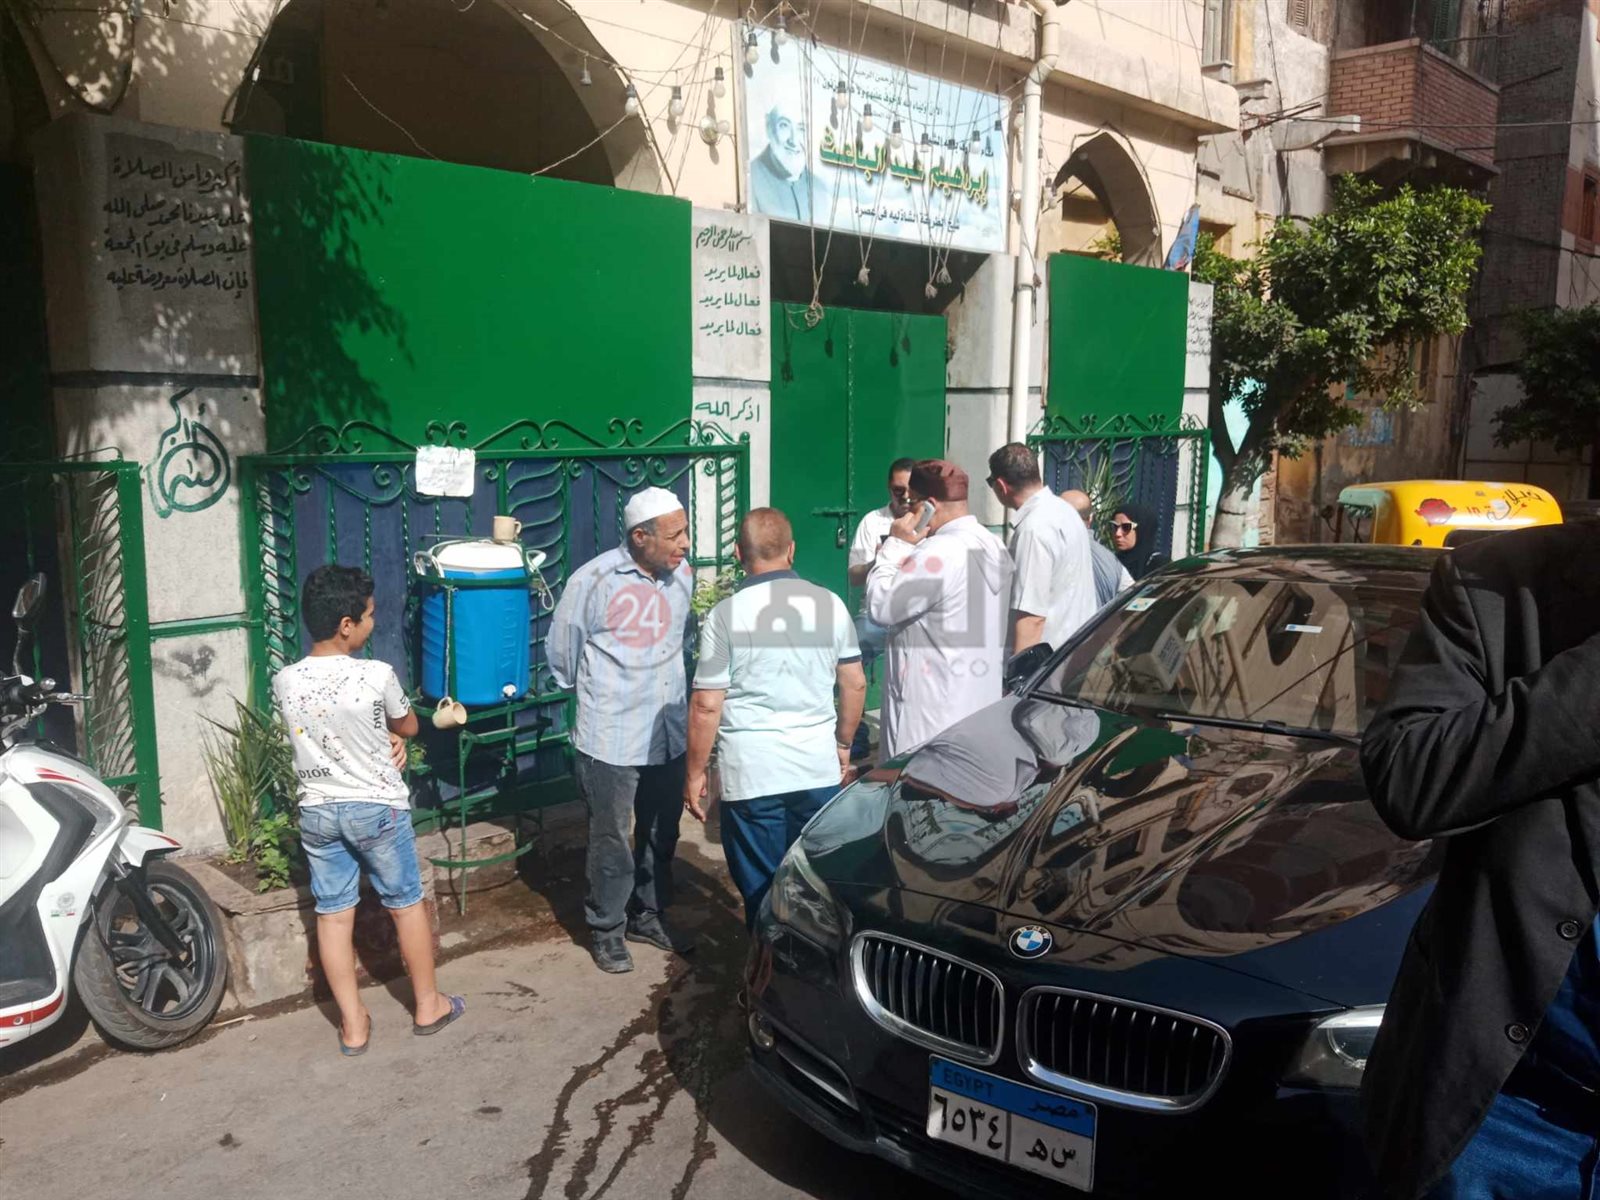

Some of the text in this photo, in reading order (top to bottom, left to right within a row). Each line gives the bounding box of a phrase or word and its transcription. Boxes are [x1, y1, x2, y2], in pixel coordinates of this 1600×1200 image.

[113, 156, 172, 179] الصلاة
[172, 167, 195, 188] من
[103, 198, 131, 218] الله
[182, 234, 214, 263] وسلم
[216, 236, 247, 261] عليه
[703, 264, 761, 283] فعال لما يريد
[699, 292, 761, 309] فعال لما يريد
[699, 319, 762, 337] فعال لما يريد
[695, 400, 730, 417] الله
[299, 767, 333, 779] DIOR
[943, 1067, 995, 1096] EGYPT
[1028, 1101, 1079, 1118] مصر
[934, 1093, 1003, 1150] ٦٥٣٤
